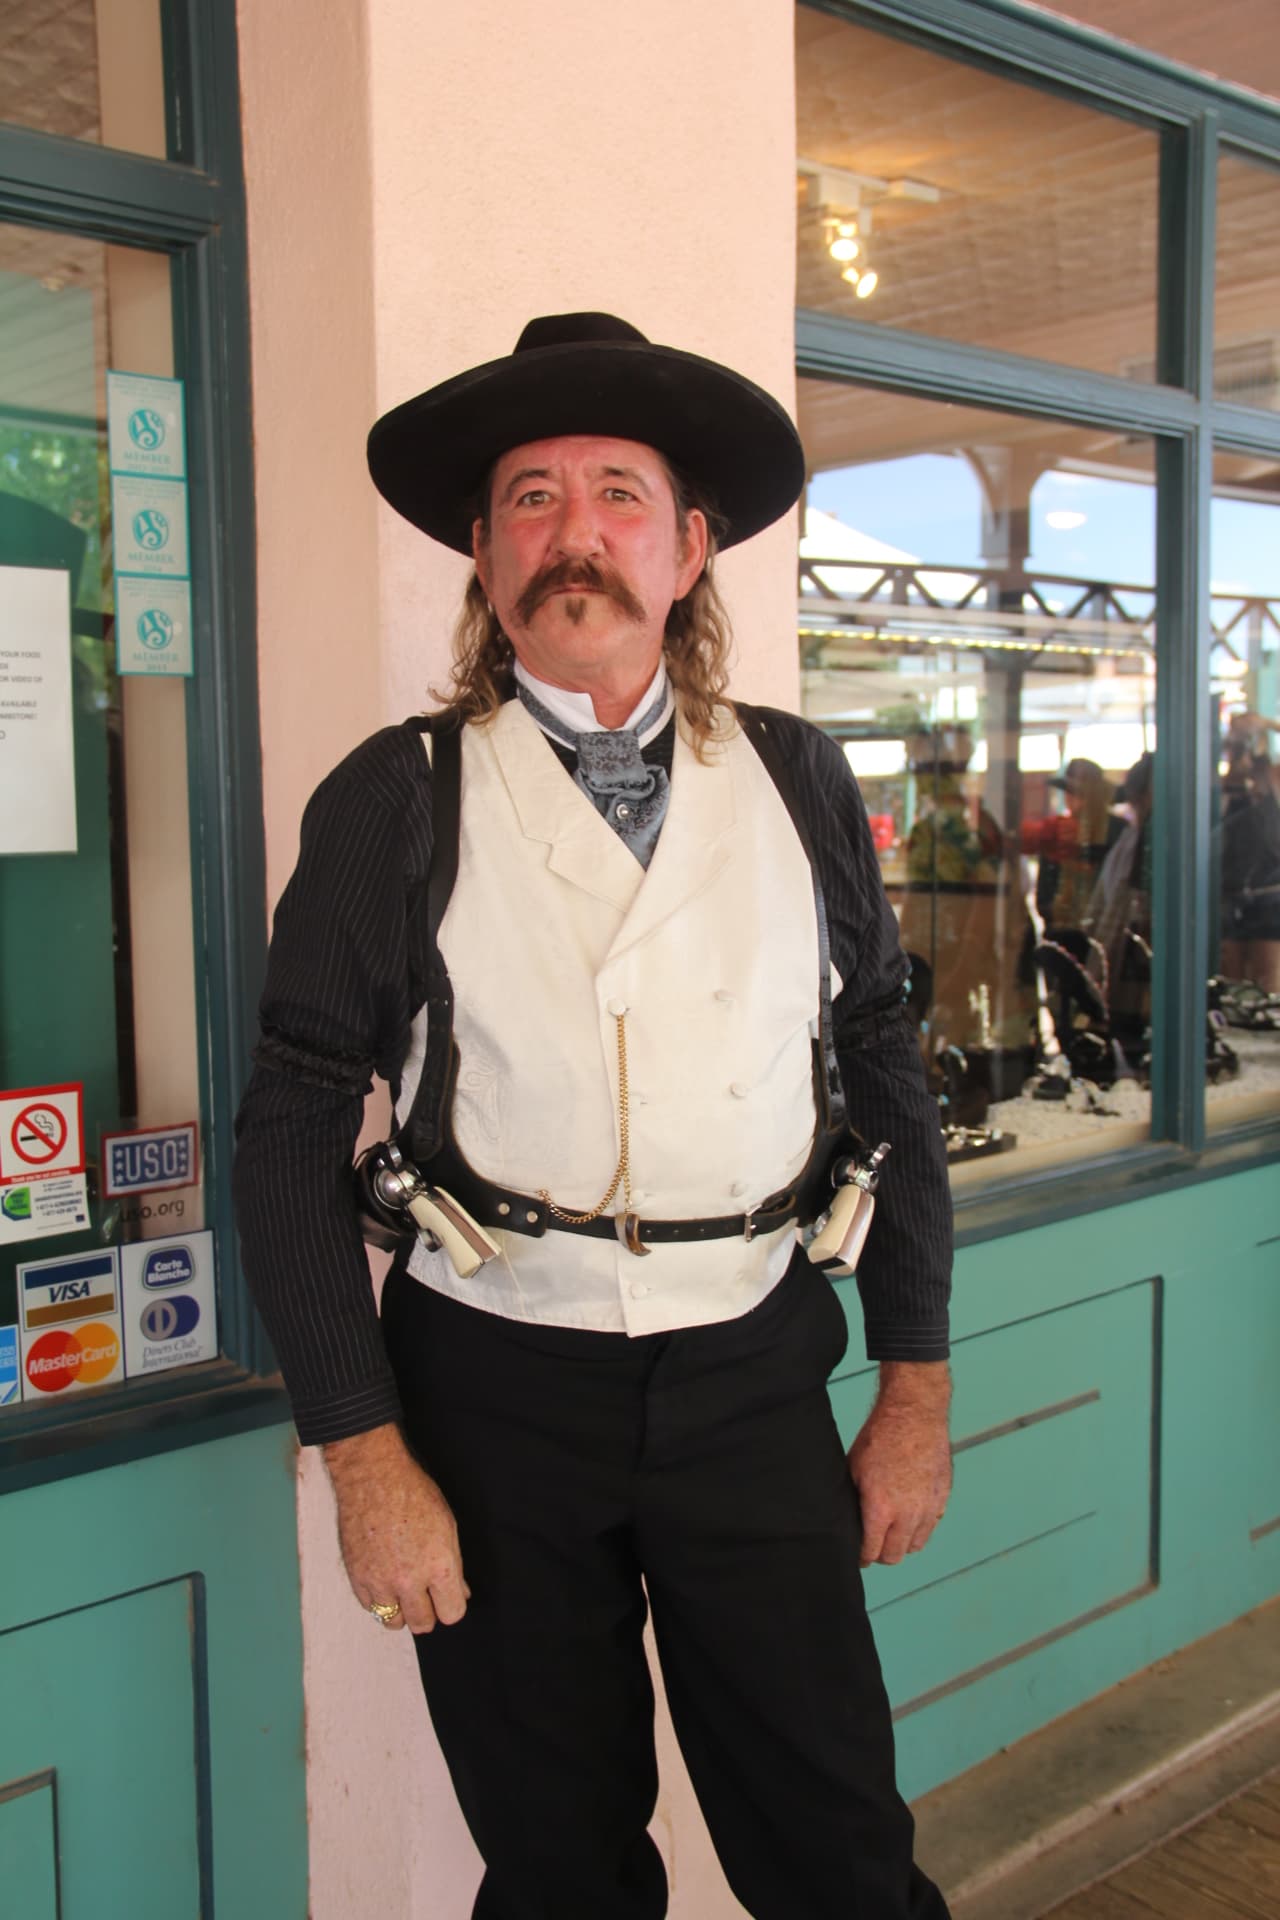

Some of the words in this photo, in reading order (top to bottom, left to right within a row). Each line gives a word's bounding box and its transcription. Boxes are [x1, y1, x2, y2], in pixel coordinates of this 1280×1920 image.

[125, 1140, 178, 1182] USO
[154, 1260, 183, 1272] Carte
[147, 1268, 190, 1284] Blanche
[48, 1280, 91, 1303] VISA
[174, 1337, 197, 1351] Club
[28, 1341, 117, 1376] MasterCard
